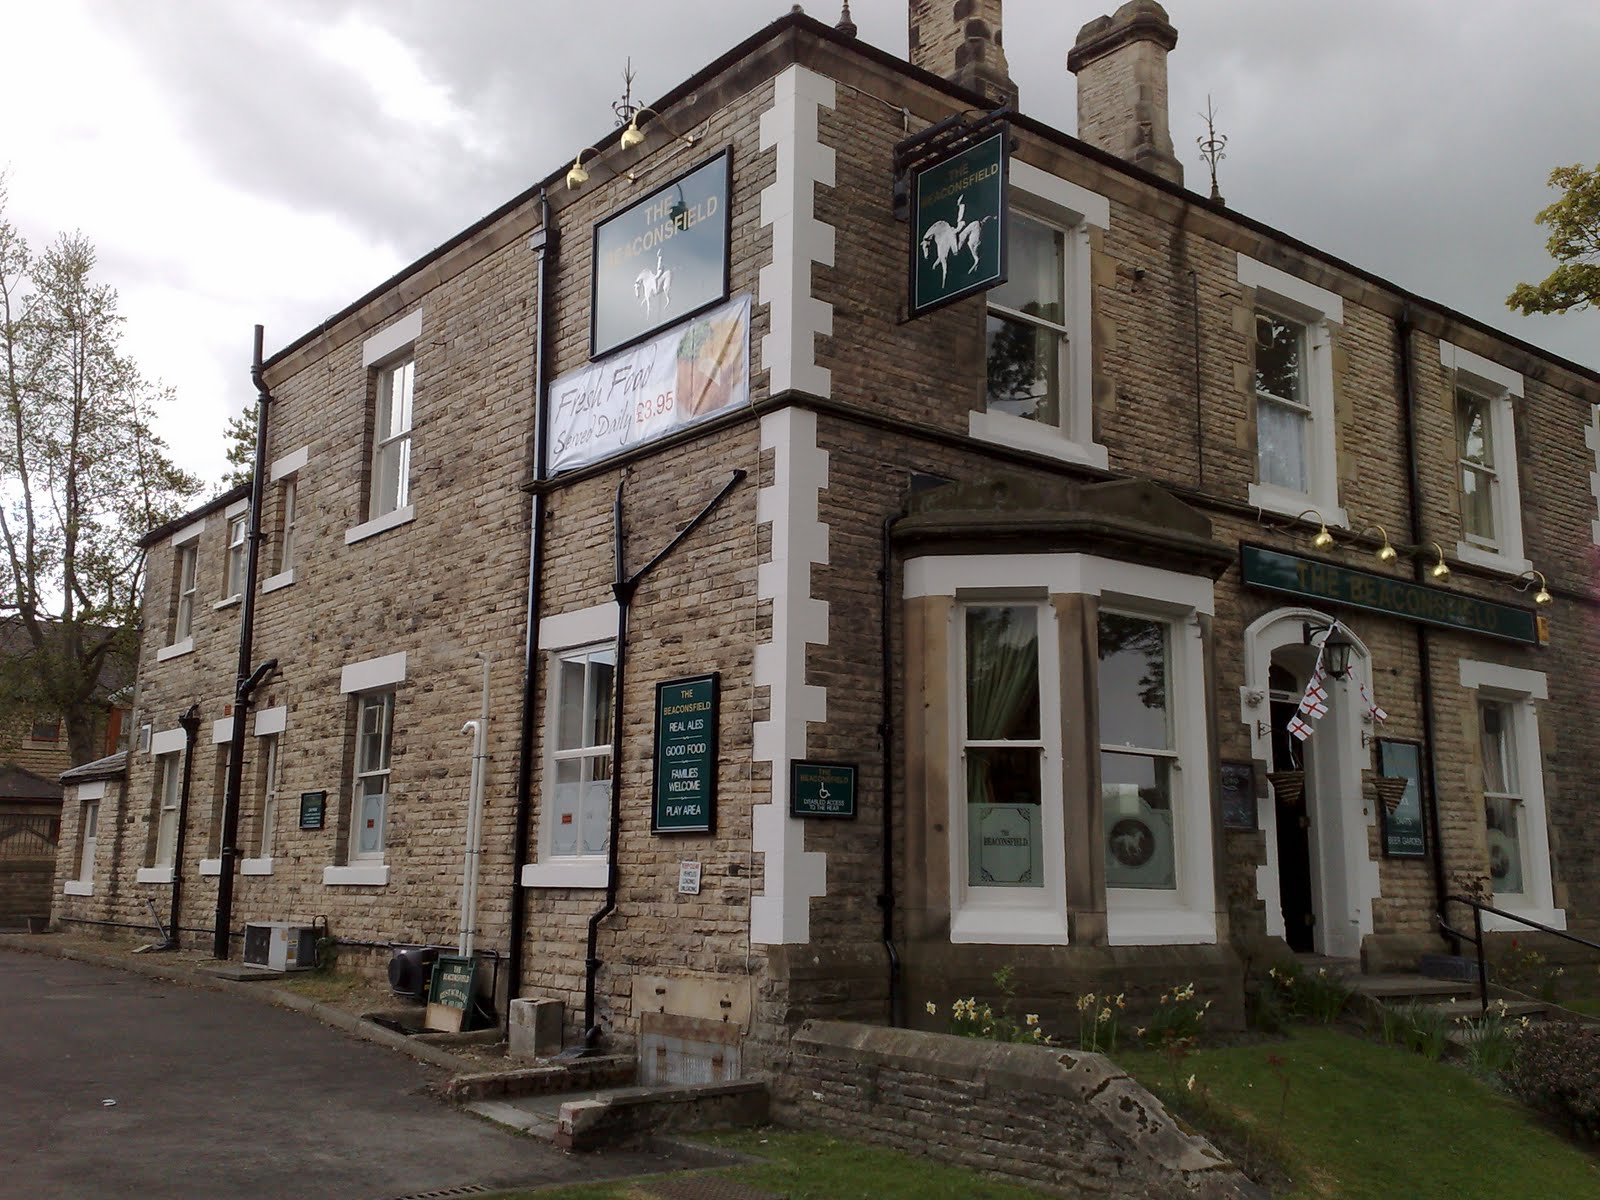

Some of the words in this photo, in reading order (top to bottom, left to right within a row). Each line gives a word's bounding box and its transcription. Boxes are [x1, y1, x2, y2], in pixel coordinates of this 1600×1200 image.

[644, 195, 673, 225] THE
[554, 366, 604, 424] Fresh
[607, 343, 658, 402] Food
[595, 400, 633, 445] Daily
[636, 391, 674, 424] £3.95
[1296, 562, 1340, 596] THE
[1349, 575, 1498, 631] BEACONSFIELD
[681, 689, 694, 699] THE
[663, 701, 711, 716] BEACONSFIELD
[669, 720, 686, 732] REAL
[687, 719, 704, 731] ALES
[665, 744, 686, 757] GOOD
[687, 742, 707, 755] FOOD
[671, 767, 699, 779] FAMILIES
[668, 780, 701, 792] WELCOME
[666, 805, 682, 817] PLAY
[683, 804, 702, 816] AREA
